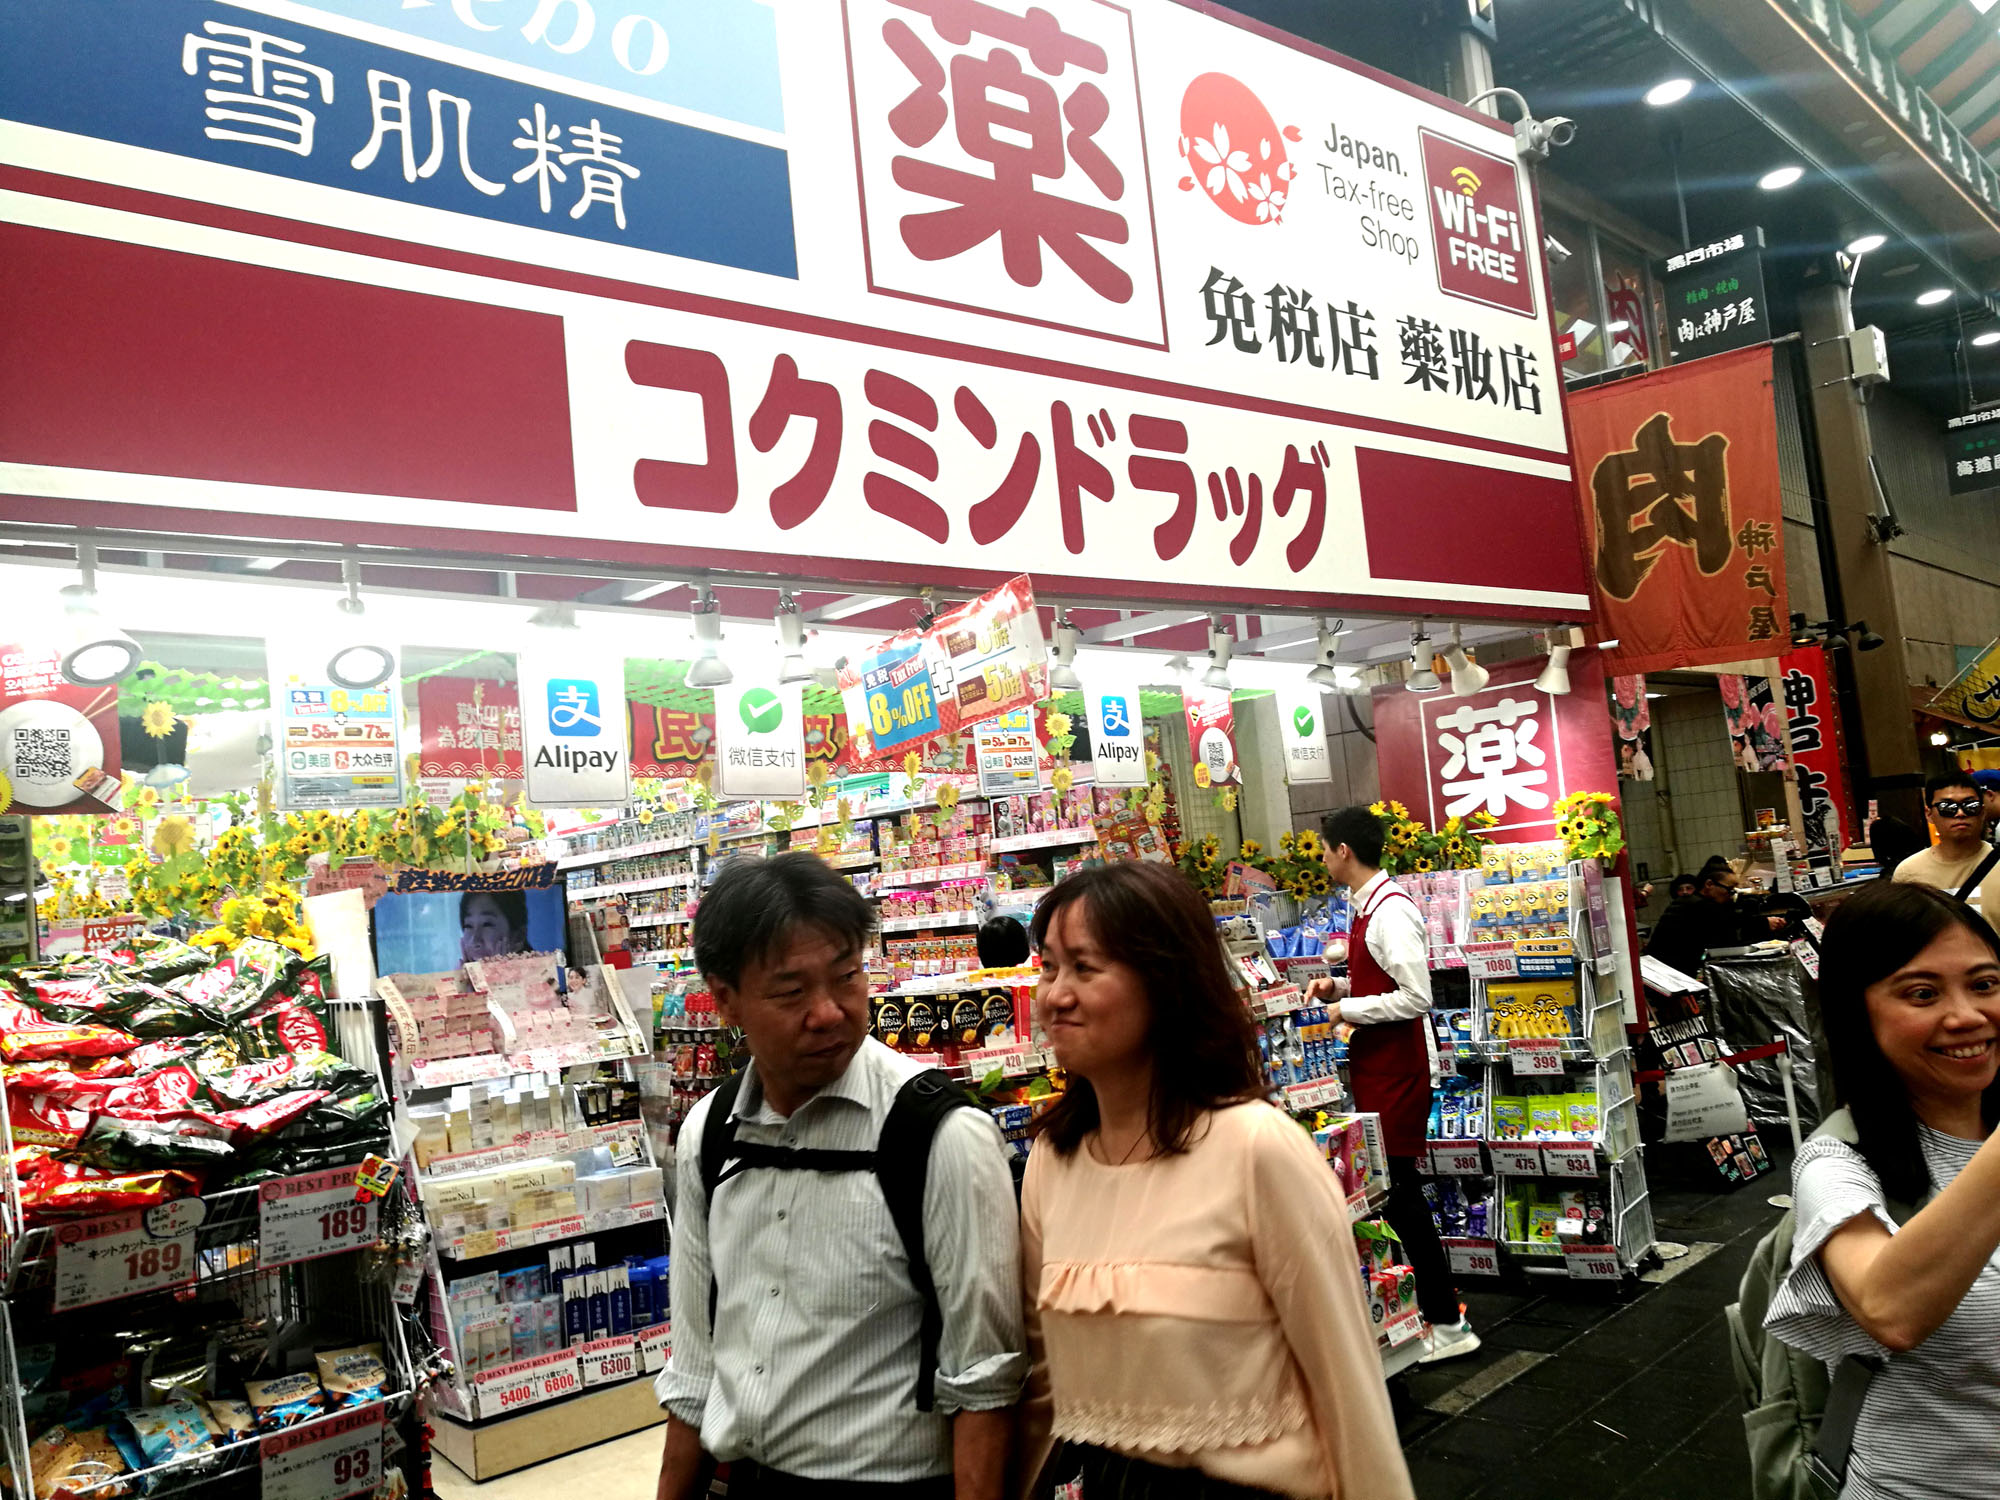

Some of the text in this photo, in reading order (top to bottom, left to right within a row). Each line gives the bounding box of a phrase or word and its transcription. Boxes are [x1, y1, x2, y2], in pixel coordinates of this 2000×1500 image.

[182, 20, 641, 230] 雪肌精
[881, 0, 1134, 304] 薬
[1323, 122, 1408, 179] Japan.
[1316, 160, 1416, 222] Tax-free
[1433, 187, 1520, 247] Wi-Fi
[1360, 213, 1420, 266] Shop
[1448, 240, 1518, 284] FREE
[1198, 266, 1380, 382] 免税店
[1677, 297, 1756, 342] 肉は神戸屋
[624, 339, 1330, 573] コクミンドラッグ
[533, 743, 618, 773] Alipay
[728, 746, 796, 768] 微信支付
[1097, 742, 1139, 762] Alipay
[1435, 697, 1550, 818] 薬
[1649, 1015, 1709, 1048] RESTAURANT
[1005, 1054, 1022, 1068] 420
[1532, 1055, 1558, 1070] 398
[1453, 1156, 1477, 1170] 380
[1514, 1157, 1537, 1171] 475
[1566, 1158, 1592, 1173] 934
[284, 1177, 326, 1196] BEST
[85, 1217, 135, 1236] BEST
[318, 1205, 368, 1241] 189
[560, 1222, 581, 1235] 9600
[124, 1242, 182, 1281] 189
[1469, 1255, 1493, 1270] 380
[1587, 1262, 1614, 1275] 1180
[600, 1356, 632, 1376] 6300
[499, 1386, 532, 1407] 5400
[544, 1373, 575, 1394] 6800
[333, 1448, 370, 1486] 93
